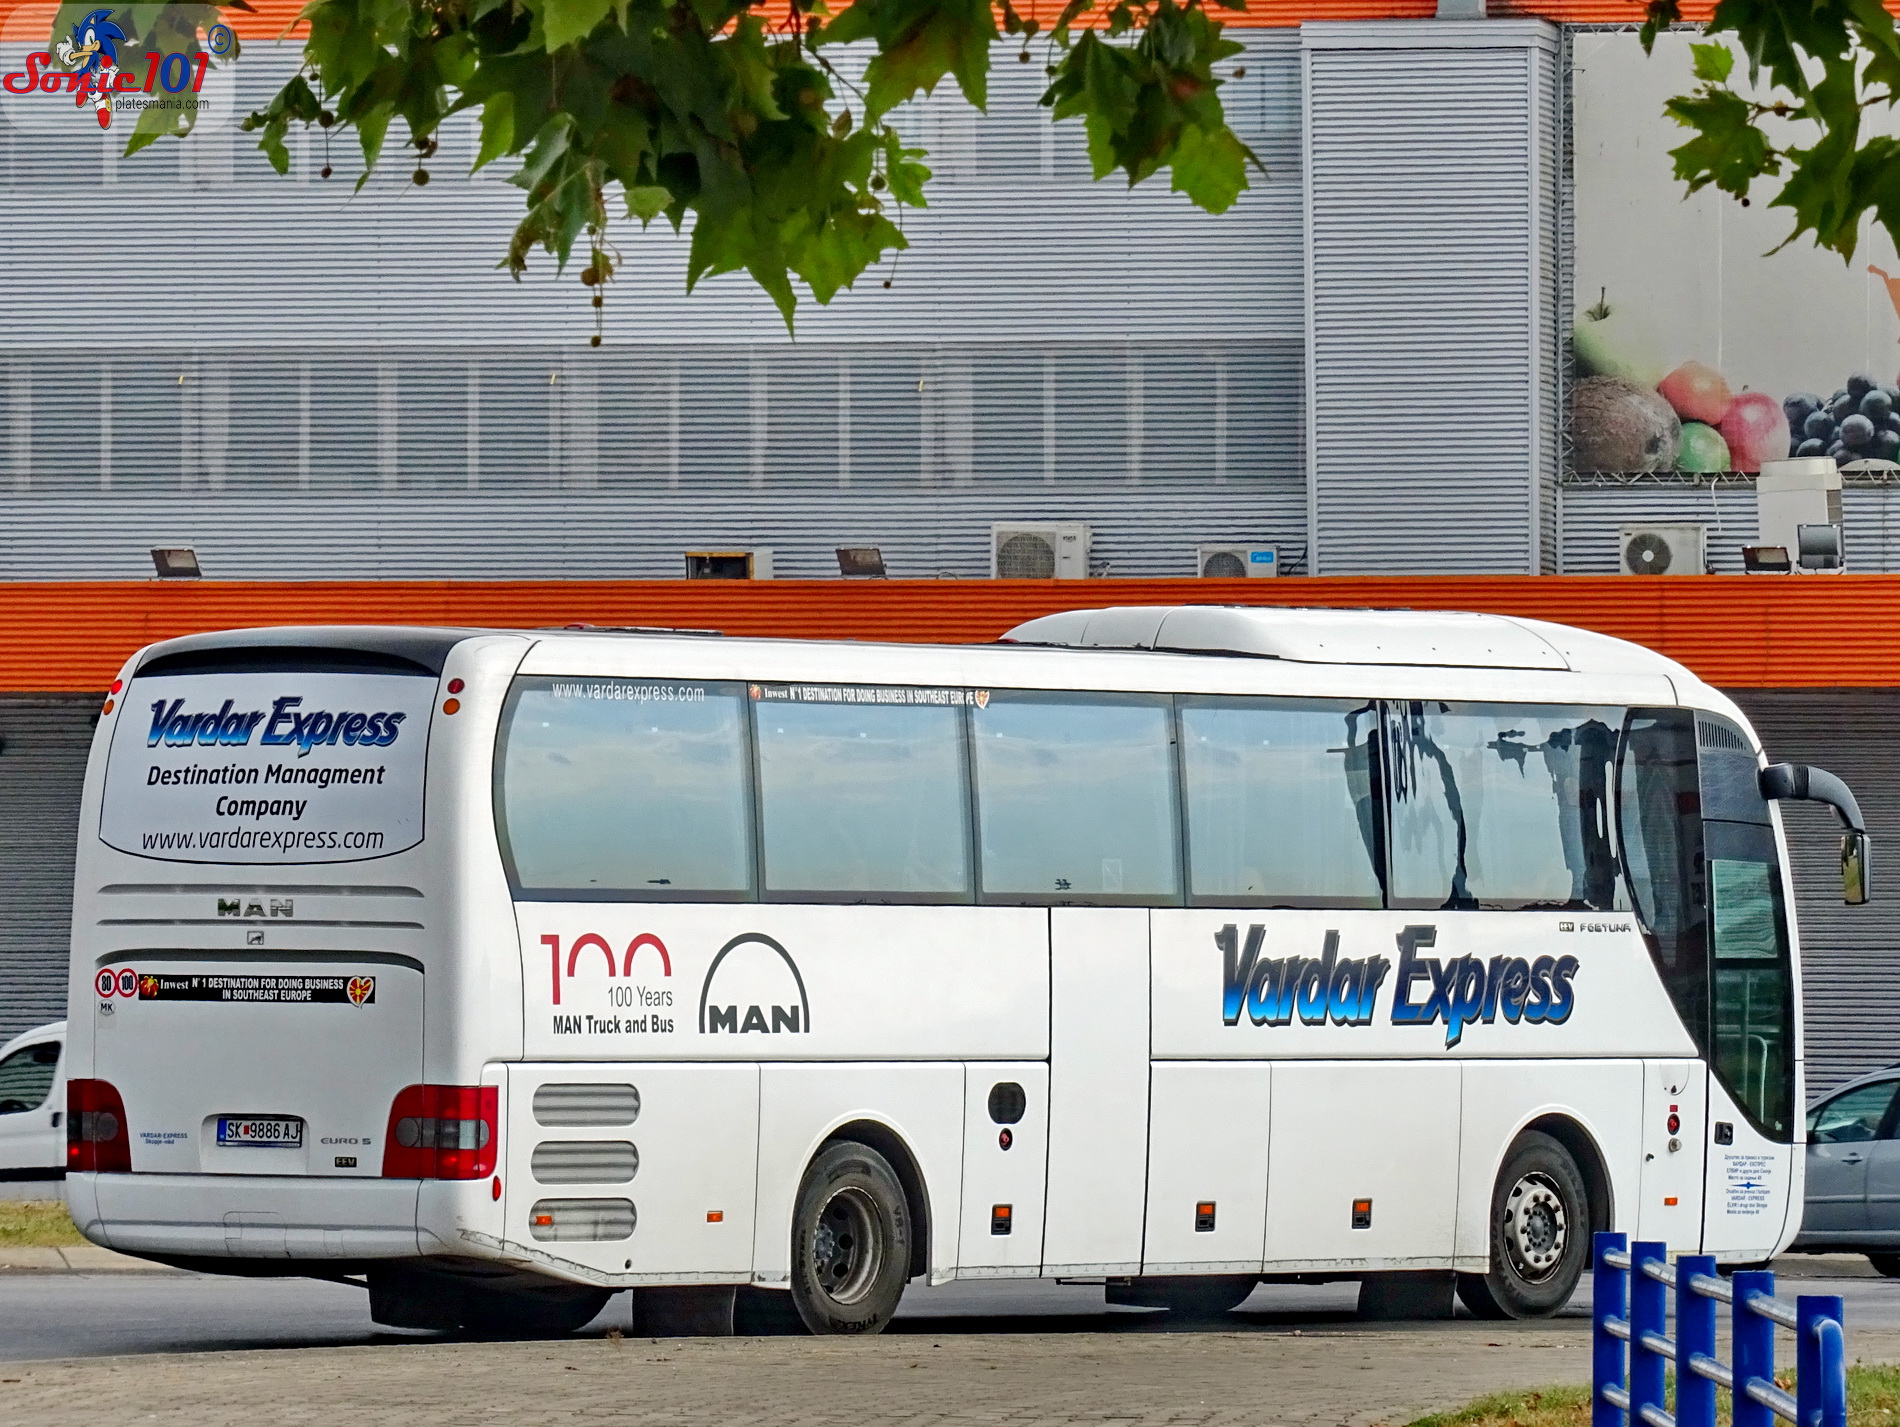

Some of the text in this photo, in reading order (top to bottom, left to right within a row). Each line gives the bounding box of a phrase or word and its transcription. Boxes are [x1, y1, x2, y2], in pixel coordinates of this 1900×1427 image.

[552, 681, 705, 705] www.vardarexpress.com
[803, 687, 843, 702] DESTINATION
[843, 688, 856, 702] FOR
[856, 688, 875, 702] DOING
[876, 689, 906, 703] BUSINESS
[907, 690, 914, 703] IN
[914, 690, 949, 704] SOUTHEAST
[147, 696, 407, 758] Vardar Express
[147, 764, 386, 788] Destination Managment
[216, 796, 307, 820] Company
[142, 826, 384, 853] www.vardarexpress.com
[217, 899, 294, 917] MAN
[101, 975, 112, 991] 80
[121, 975, 133, 991] 100
[160, 979, 189, 990] Inwest
[208, 977, 259, 989] DESTINATION
[261, 978, 277, 989] FOR
[278, 978, 303, 990] DOING
[305, 979, 344, 990] BUSINESS
[1214, 923, 1580, 1050] Vardar Express
[222, 989, 312, 1001] IN SOUTHEAST EUROPE
[608, 985, 673, 1007] 100 Years
[100, 1002, 113, 1012] MK
[553, 1014, 674, 1034] MAN Truck and Bus
[709, 1005, 800, 1033] MAN
[227, 1122, 299, 1139] SK 9886 AJ
[320, 1137, 359, 1145] EURO
[336, 1158, 355, 1166] EEV
